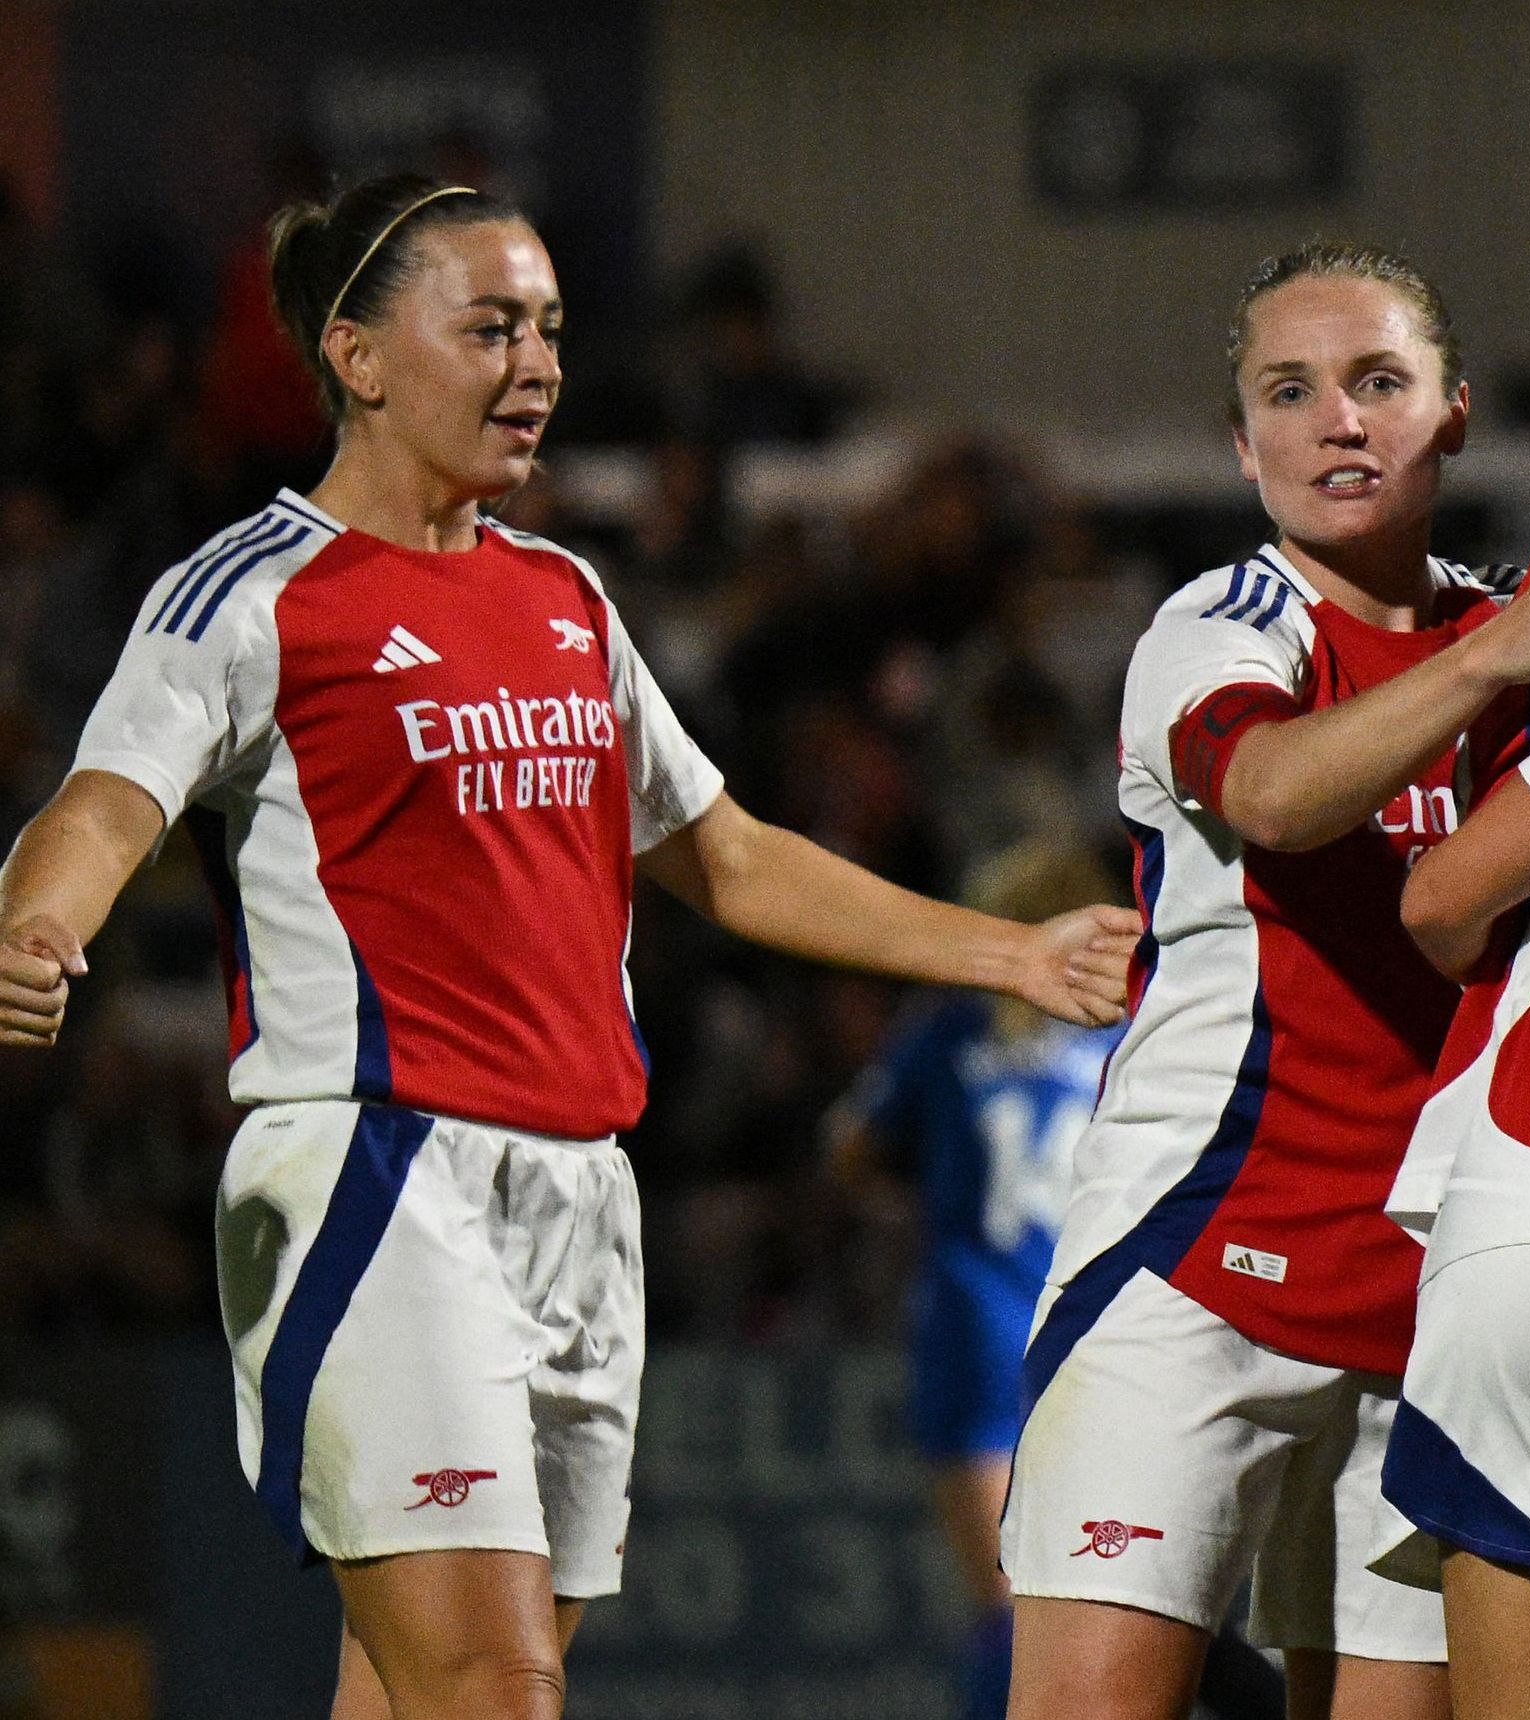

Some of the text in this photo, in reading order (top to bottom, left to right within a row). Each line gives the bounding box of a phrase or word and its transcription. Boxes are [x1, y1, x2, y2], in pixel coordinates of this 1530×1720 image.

[395, 686, 615, 764] Emirates
[456, 756, 597, 816] FLY BETTER
